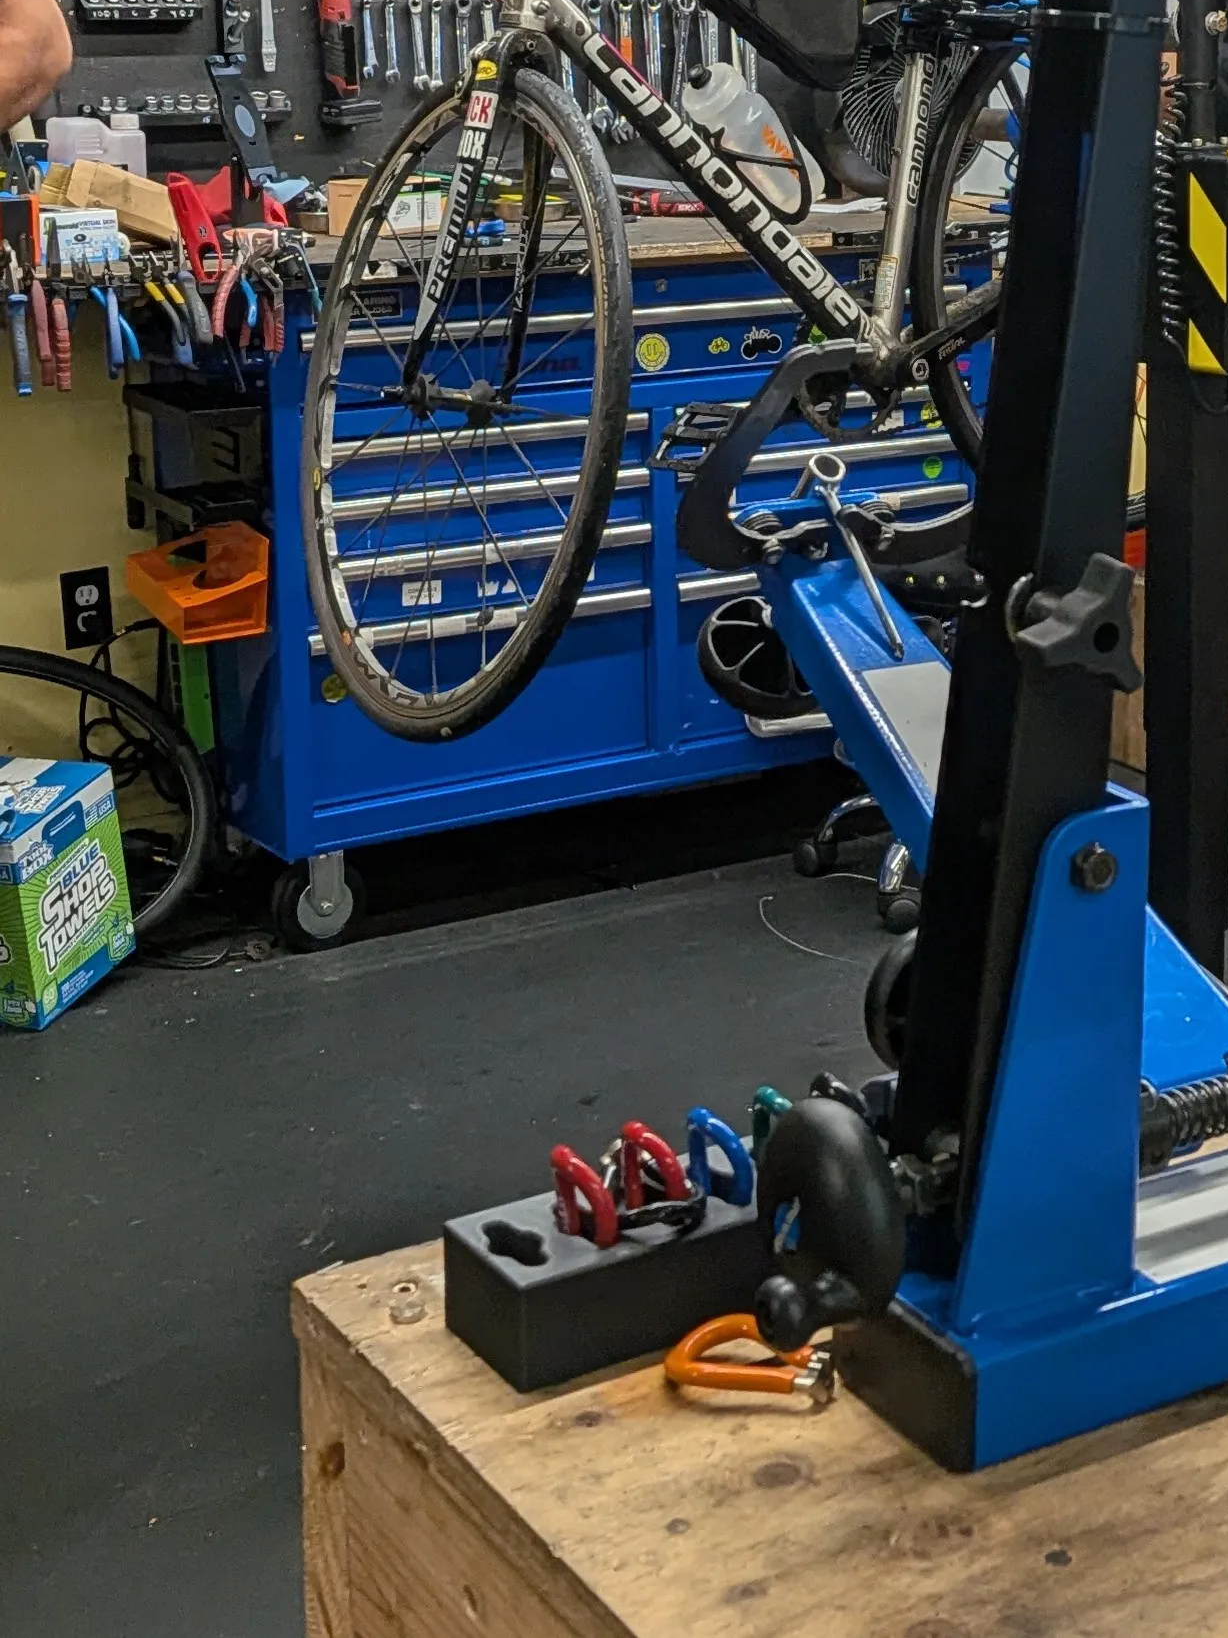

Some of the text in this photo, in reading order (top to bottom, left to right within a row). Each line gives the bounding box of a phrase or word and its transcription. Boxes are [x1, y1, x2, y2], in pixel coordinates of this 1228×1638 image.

[468, 95, 492, 123] CK
[100, 800, 113, 814] USA
[22, 852, 54, 882] BOX
[62, 843, 99, 889] BLUE
[42, 855, 106, 928] SHOP
[40, 872, 116, 971] TOWELS
